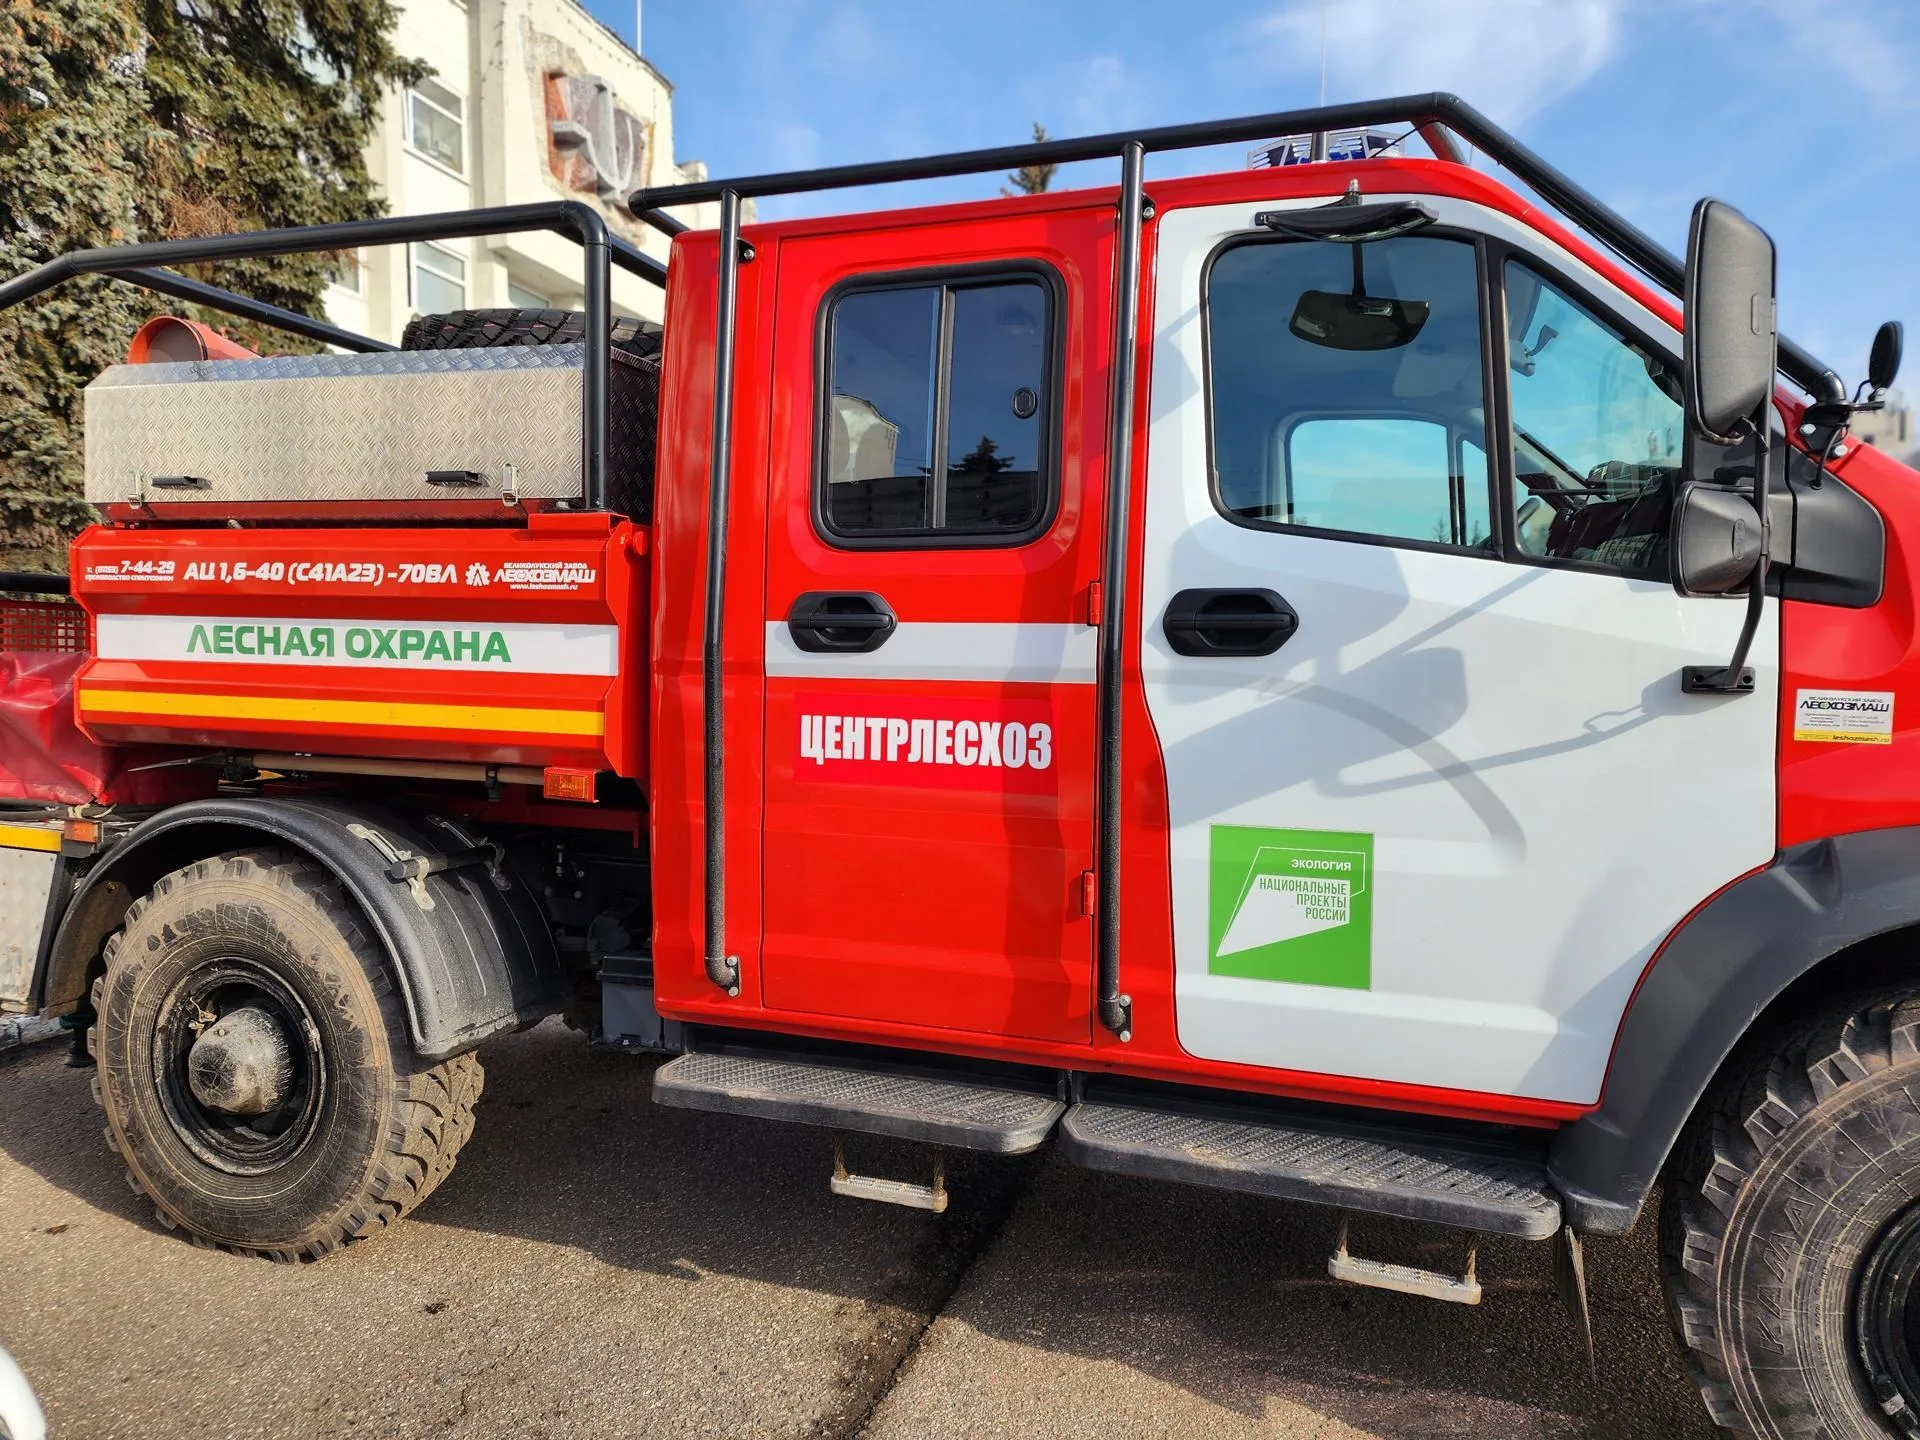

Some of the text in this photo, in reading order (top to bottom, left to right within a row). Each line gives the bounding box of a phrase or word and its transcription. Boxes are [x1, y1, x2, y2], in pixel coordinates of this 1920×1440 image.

[121, 560, 176, 575] 7-44-29
[183, 562, 215, 581] АЦ
[219, 562, 285, 584] 1,6-40
[493, 568, 597, 584] ЛЕСХОЗМАШ
[509, 583, 579, 591] www.leshozmash.ru
[186, 624, 513, 663] ЛЕСНАЯ ОХРАНА
[1800, 700, 1890, 712] ЛЕСХОЗМАШ
[800, 714, 1052, 770] ЦЕНТРЛЕСХОЗ
[1291, 859, 1352, 871] ЭКОЛОГИЯ
[1259, 878, 1348, 896] НАЦИОНАЛЬНЫЕ
[1296, 893, 1347, 909] ПРОЕКТЫ
[1305, 907, 1347, 922] РОССИИ
